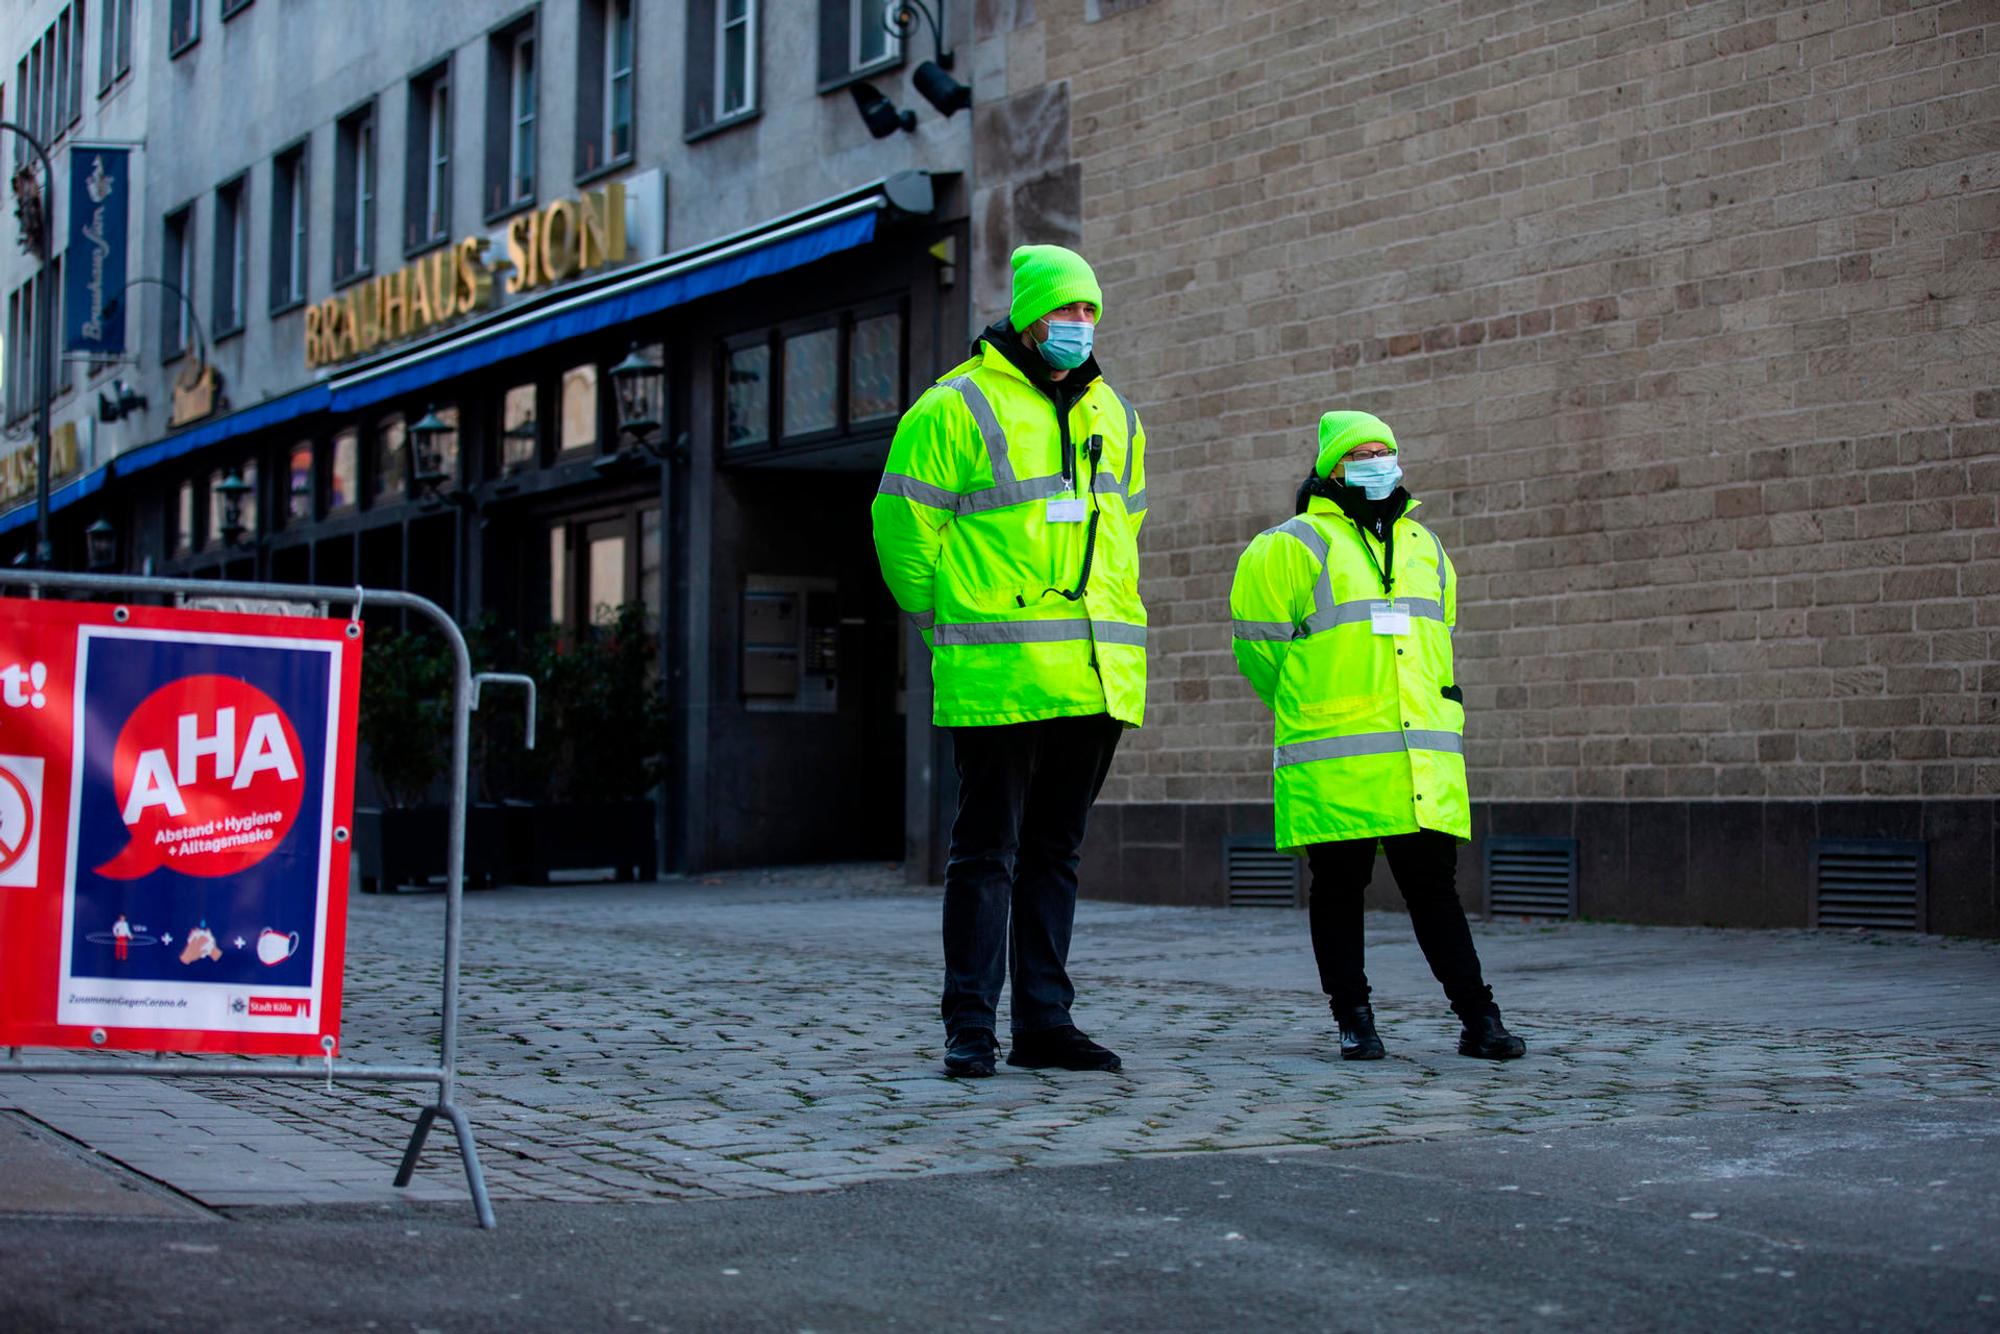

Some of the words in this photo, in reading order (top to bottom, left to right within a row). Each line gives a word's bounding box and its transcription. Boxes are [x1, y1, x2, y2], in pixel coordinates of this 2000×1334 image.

[305, 236, 489, 369] BRAUHAUS
[506, 183, 627, 294] SION
[122, 707, 299, 826] AHA
[155, 820, 214, 845] Abstand
[224, 810, 283, 832] Hygiene
[179, 828, 273, 856] Alltagsmaske
[250, 1001, 272, 1012] Stadt
[273, 1002, 293, 1013] Köln
